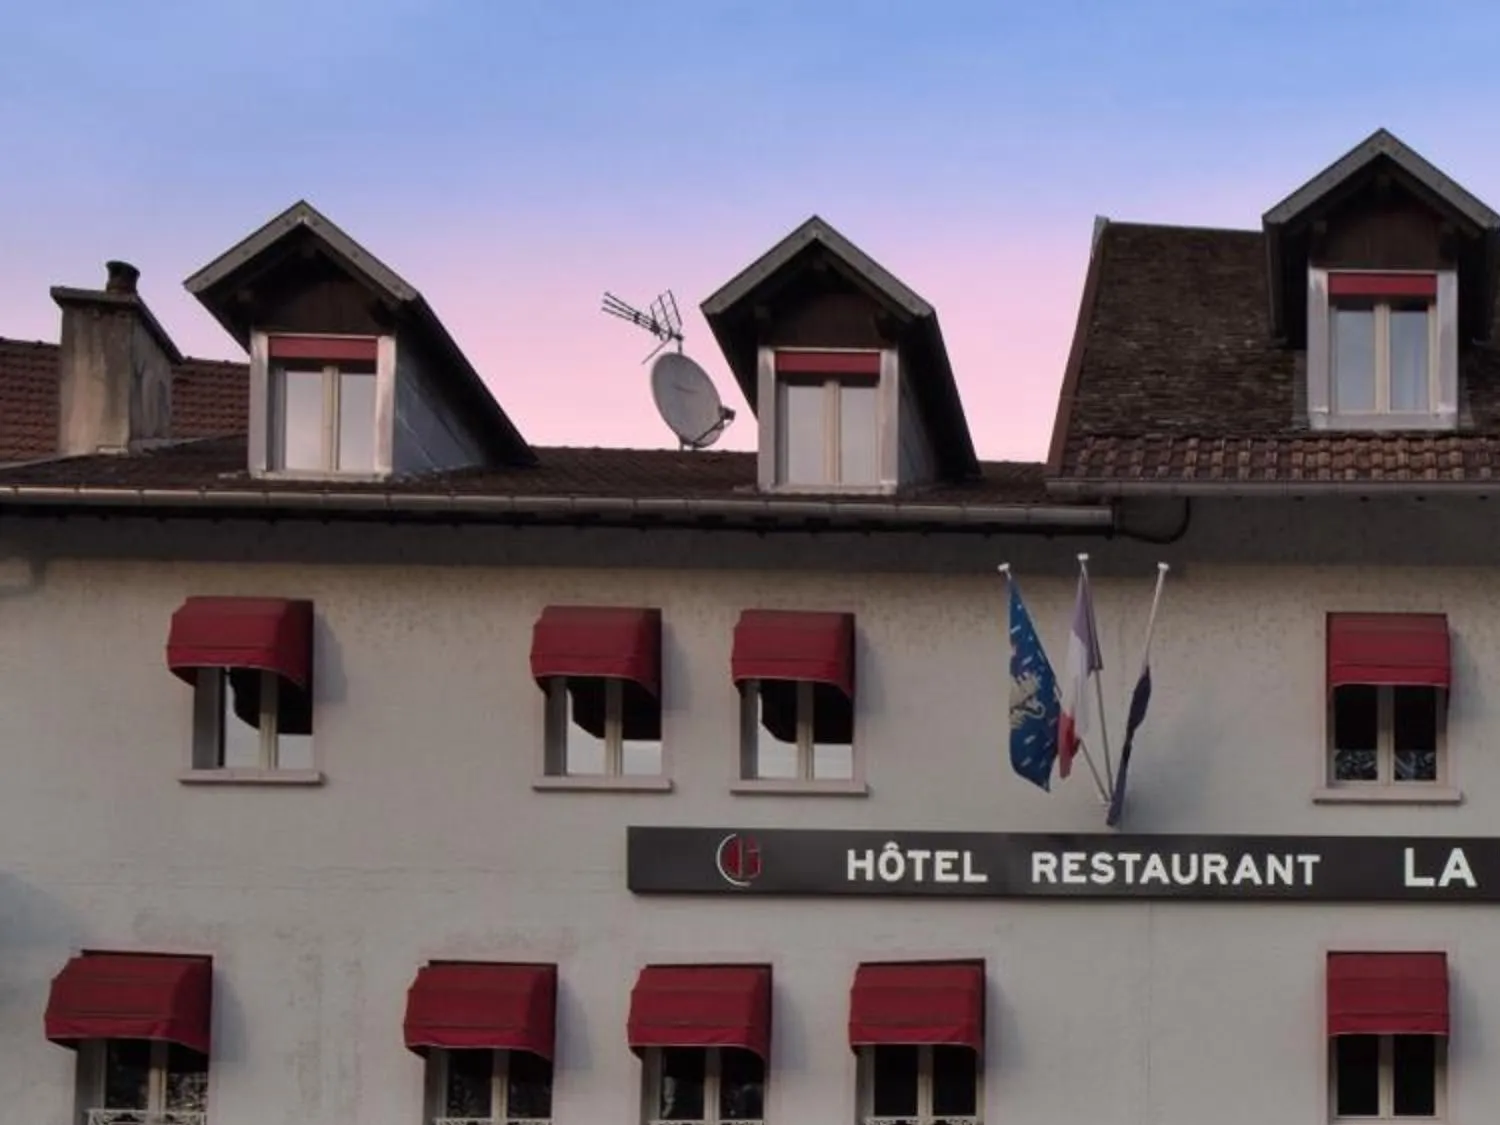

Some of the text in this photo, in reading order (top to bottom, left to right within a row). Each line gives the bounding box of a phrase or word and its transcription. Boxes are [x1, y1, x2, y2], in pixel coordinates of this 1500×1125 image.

[847, 841, 988, 883] HÔTEL
[1031, 851, 1321, 886] RESTAURANT
[1404, 847, 1477, 888] LA
